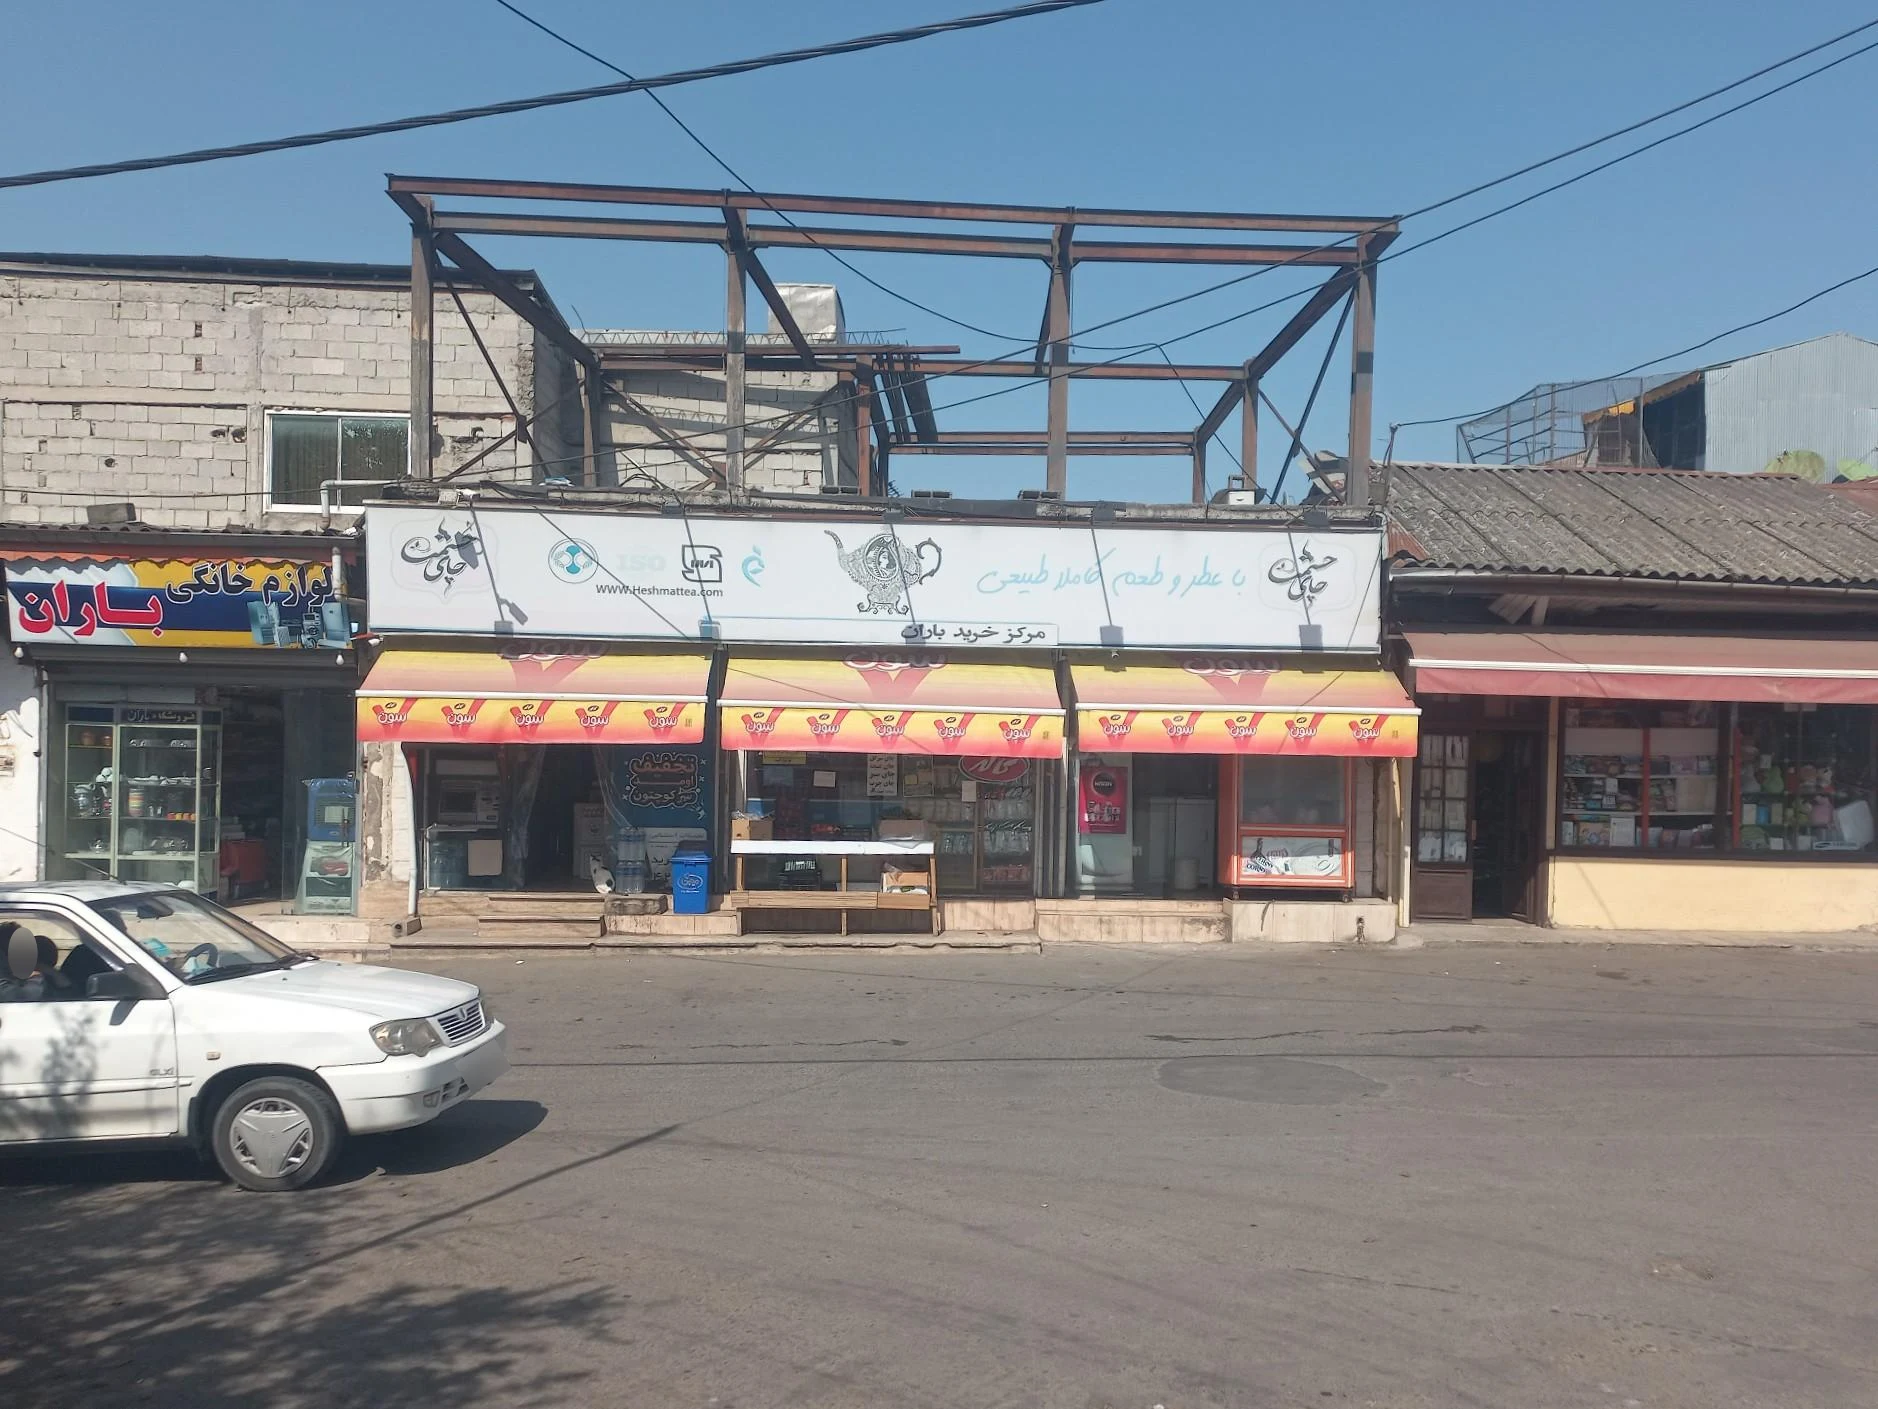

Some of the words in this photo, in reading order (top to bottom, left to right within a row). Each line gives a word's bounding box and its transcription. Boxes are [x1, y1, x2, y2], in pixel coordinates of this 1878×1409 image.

[616, 554, 666, 571] ISO
[976, 553, 1049, 594] طبیعی
[1113, 554, 1164, 597] طعم
[1180, 555, 1222, 598] عطر
[166, 562, 254, 604] خانگی
[262, 566, 335, 607] لوازم
[18, 579, 164, 637] باران
[901, 623, 946, 643] باران
[953, 625, 999, 643] خرید
[1003, 626, 1046, 643] مرکز
[378, 711, 407, 724] سون
[447, 712, 476, 725] سون
[515, 713, 544, 725] سون
[580, 714, 609, 726] سون
[649, 715, 678, 728] سون
[746, 721, 774, 733] سون
[812, 722, 840, 734] سون
[876, 723, 904, 736] سون
[938, 726, 966, 738] سون
[1003, 728, 1031, 739] سون
[1104, 724, 1131, 736] سون
[1167, 725, 1194, 737] سون
[1230, 725, 1257, 737] سون
[1290, 726, 1317, 738] سون
[1353, 727, 1380, 739] سون
[632, 756, 695, 775] تخفیف
